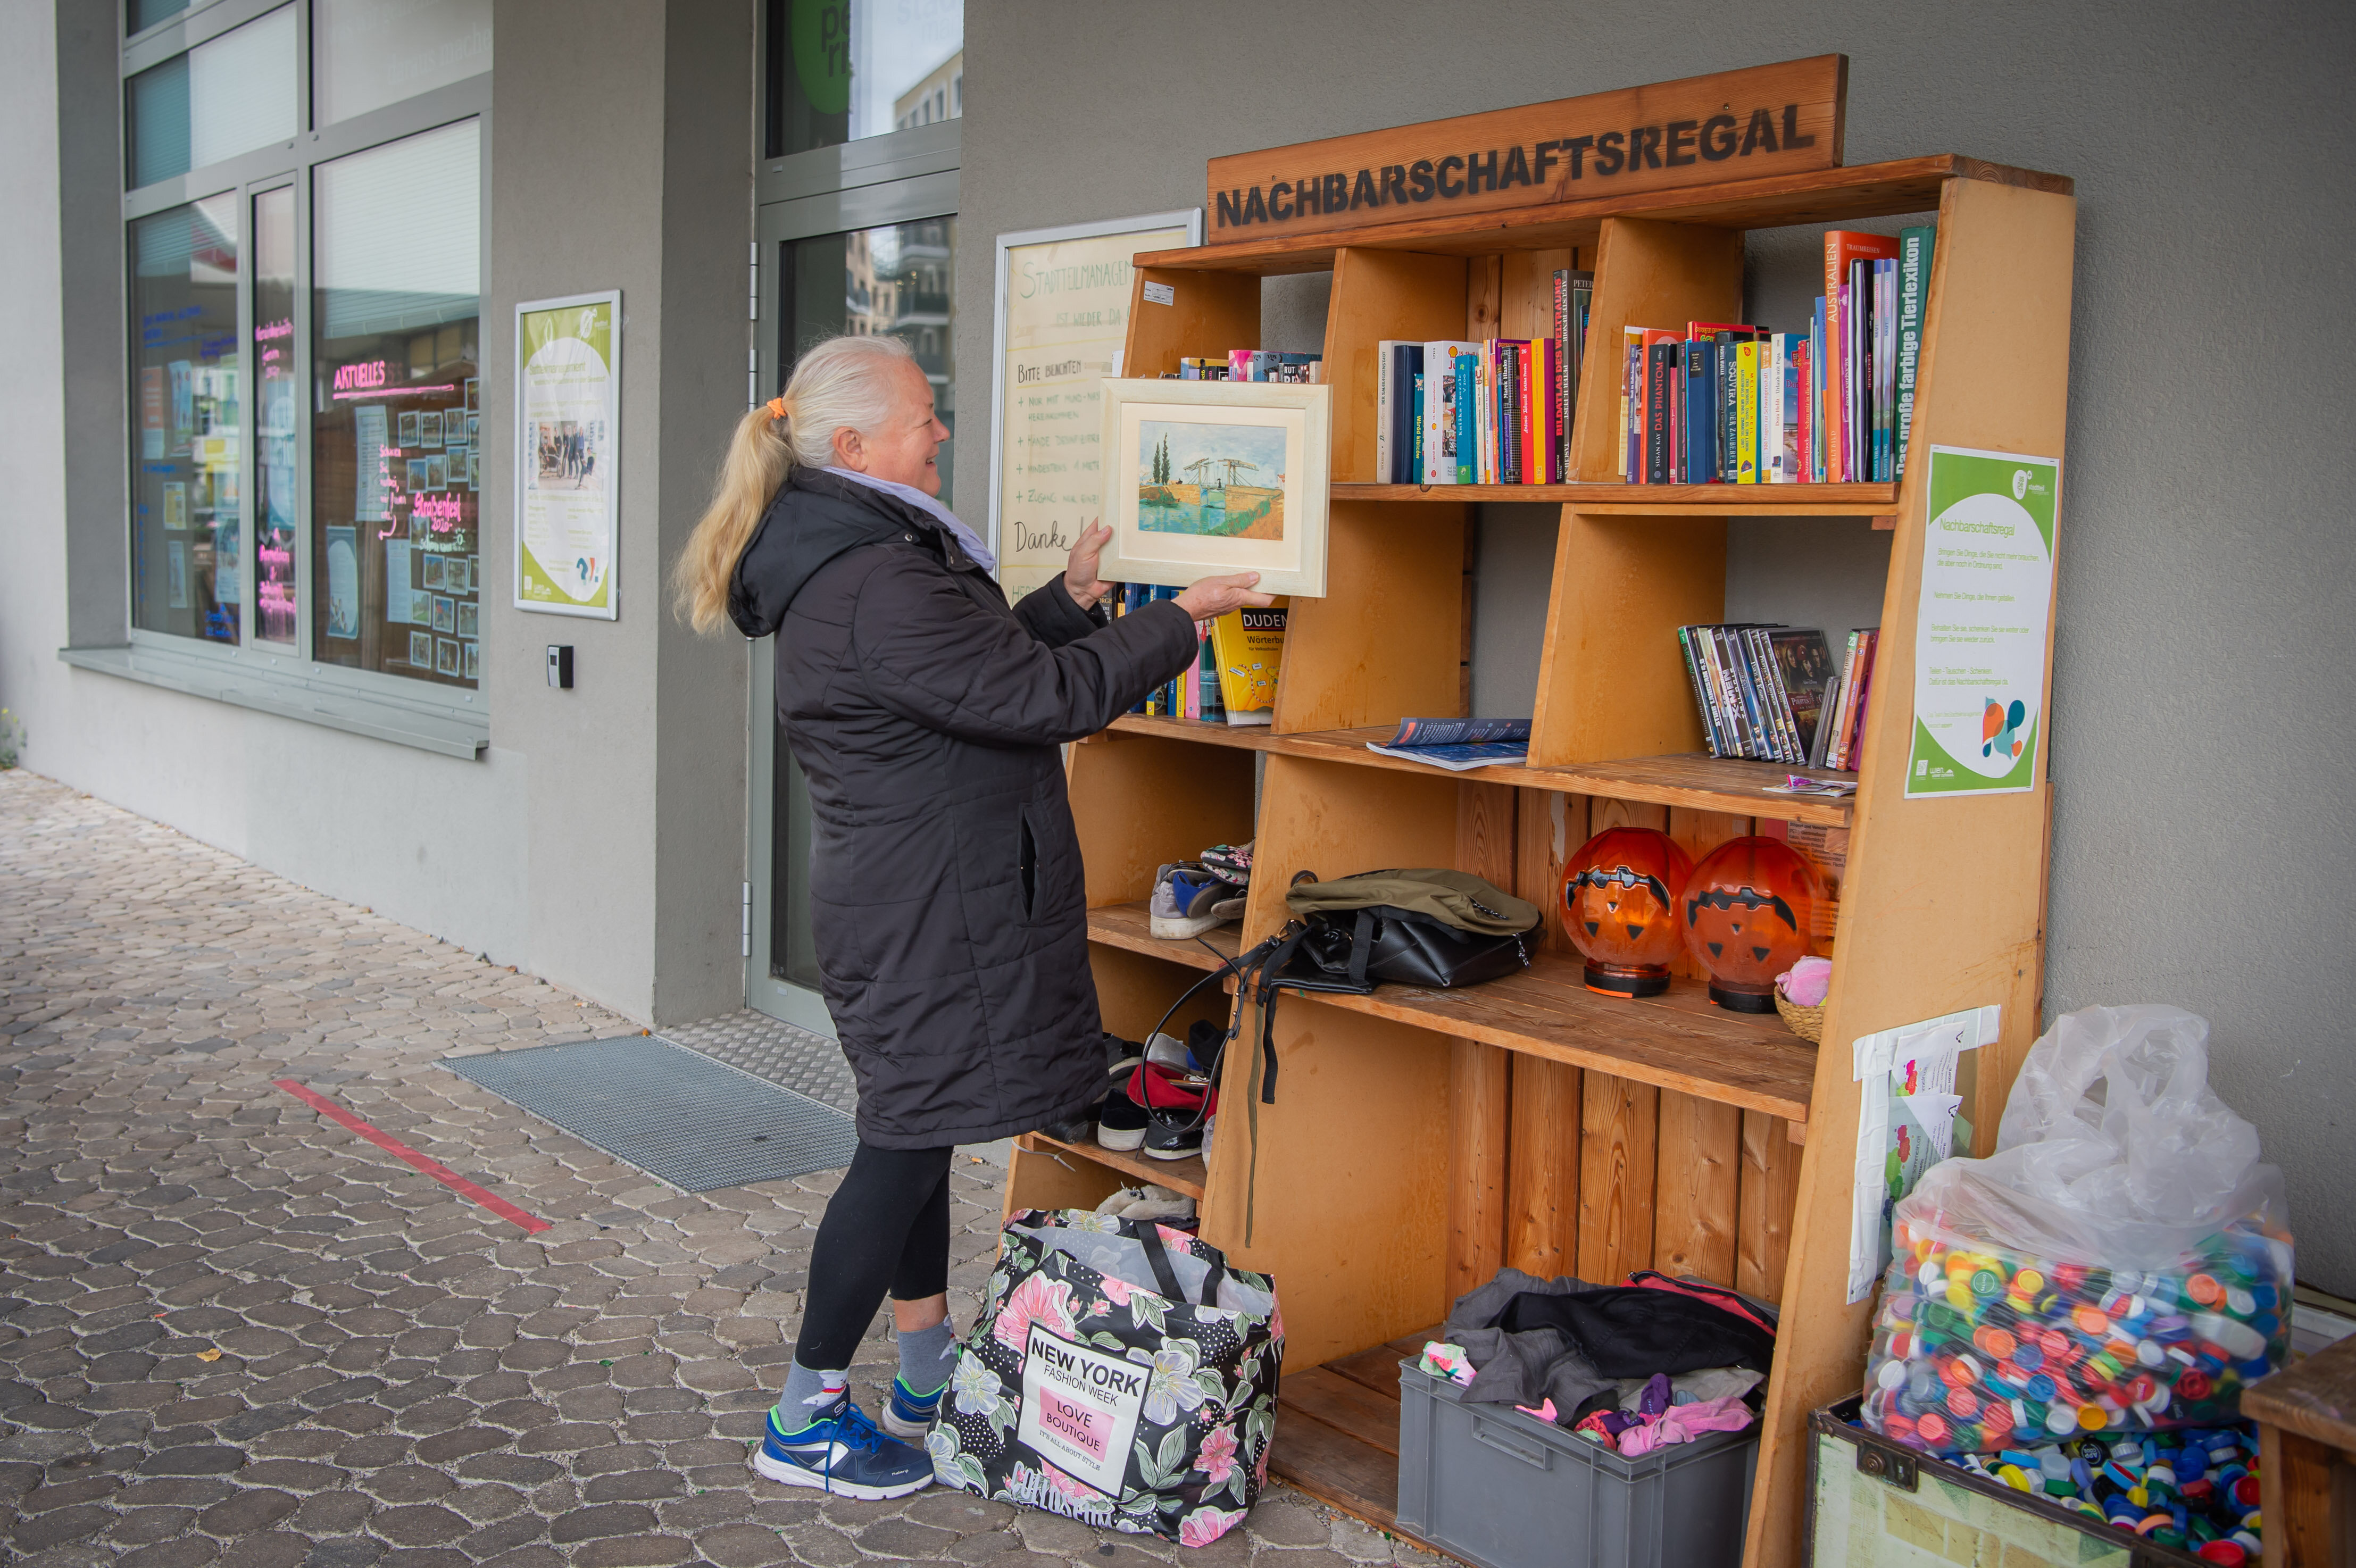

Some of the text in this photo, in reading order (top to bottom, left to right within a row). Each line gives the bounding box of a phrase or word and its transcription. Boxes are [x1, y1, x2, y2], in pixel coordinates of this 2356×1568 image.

[1216, 104, 1815, 228] NACHBARSCHAFTSREGAL
[1846, 244, 1880, 254] TRAUMREISEN
[1827, 243, 1837, 323] AUSTRALIEN
[1901, 237, 1919, 330] Tierlexikon
[1057, 308, 1120, 327] IST WIEDER DA
[334, 360, 386, 390] AKTUELLES
[1018, 360, 1081, 383] BITTE BEACHTEN
[1899, 331, 1919, 390] farbige
[1655, 362, 1663, 409] PHANTOM
[1728, 361, 1736, 406] SOUVIRA
[1029, 395, 1059, 407] NUR MIT
[1896, 444, 1908, 474] Das
[412, 491, 461, 522] Straßenfest
[1028, 489, 1056, 503] ZUGANG
[1014, 520, 1072, 552] Danke
[1940, 518, 2015, 538] Nachbarschaftsregal
[1938, 547, 1955, 557] Bringen
[1973, 560, 1992, 571] Ordnung
[1243, 614, 1287, 627] DUDEN
[1847, 637, 1857, 647] 23
[1930, 635, 1947, 644] bringen
[1682, 644, 1695, 675] ARROW
[1759, 655, 1767, 673] PIRATES
[1841, 650, 1853, 690] Wien Liesing
[1703, 671, 1716, 704] LANGSAM
[1722, 669, 1742, 720] X-MEN
[1713, 705, 1721, 727] STIRB
[1031, 1337, 1142, 1398] NEW YORK
[1044, 1364, 1119, 1407] FASHION WEEK
[1057, 1400, 1093, 1428] LOVE
[1046, 1412, 1100, 1452] BOUTIQUE
[1039, 1429, 1100, 1471] IT'S ALL ABOUT STYLE
